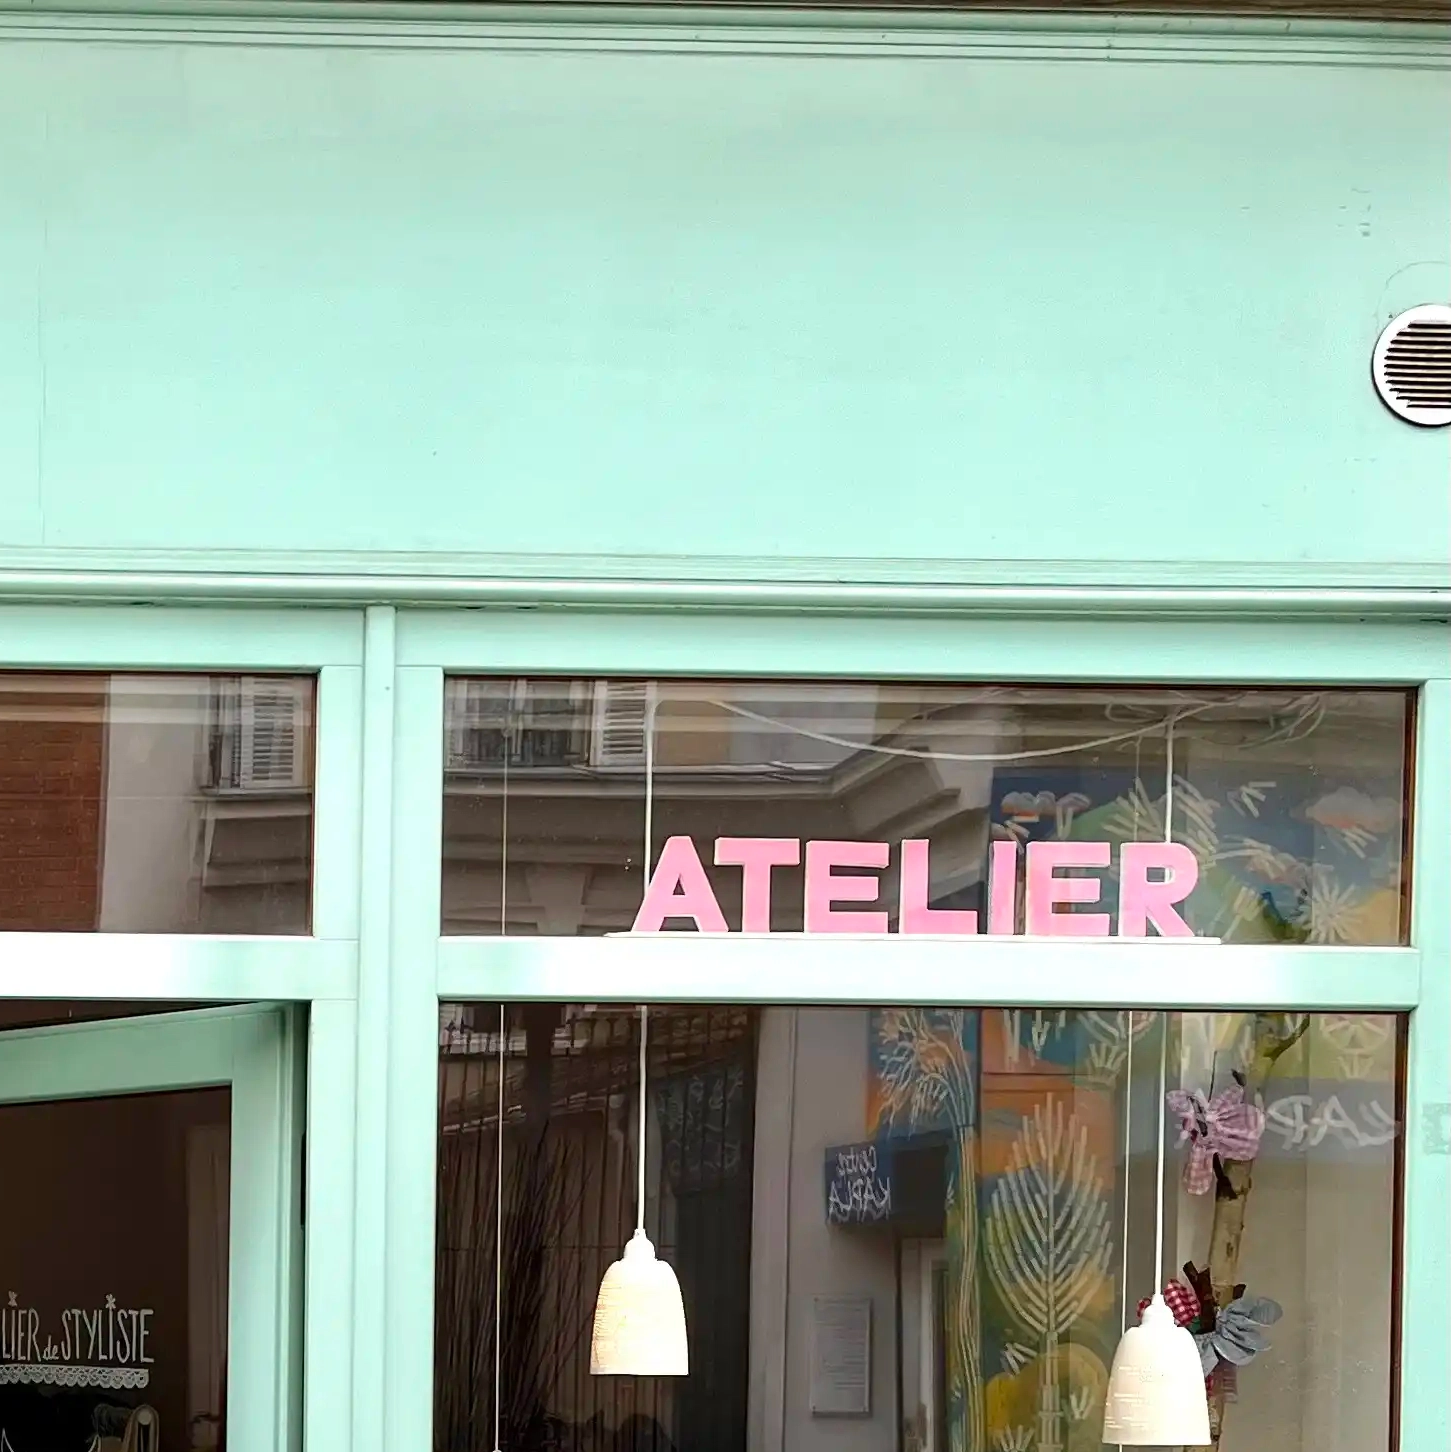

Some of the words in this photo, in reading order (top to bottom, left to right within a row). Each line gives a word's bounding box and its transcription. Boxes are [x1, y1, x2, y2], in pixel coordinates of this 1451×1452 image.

[631, 836, 1199, 937] ATELIER
[43, 1335, 60, 1360] de
[61, 1294, 154, 1363] STYLISTE
